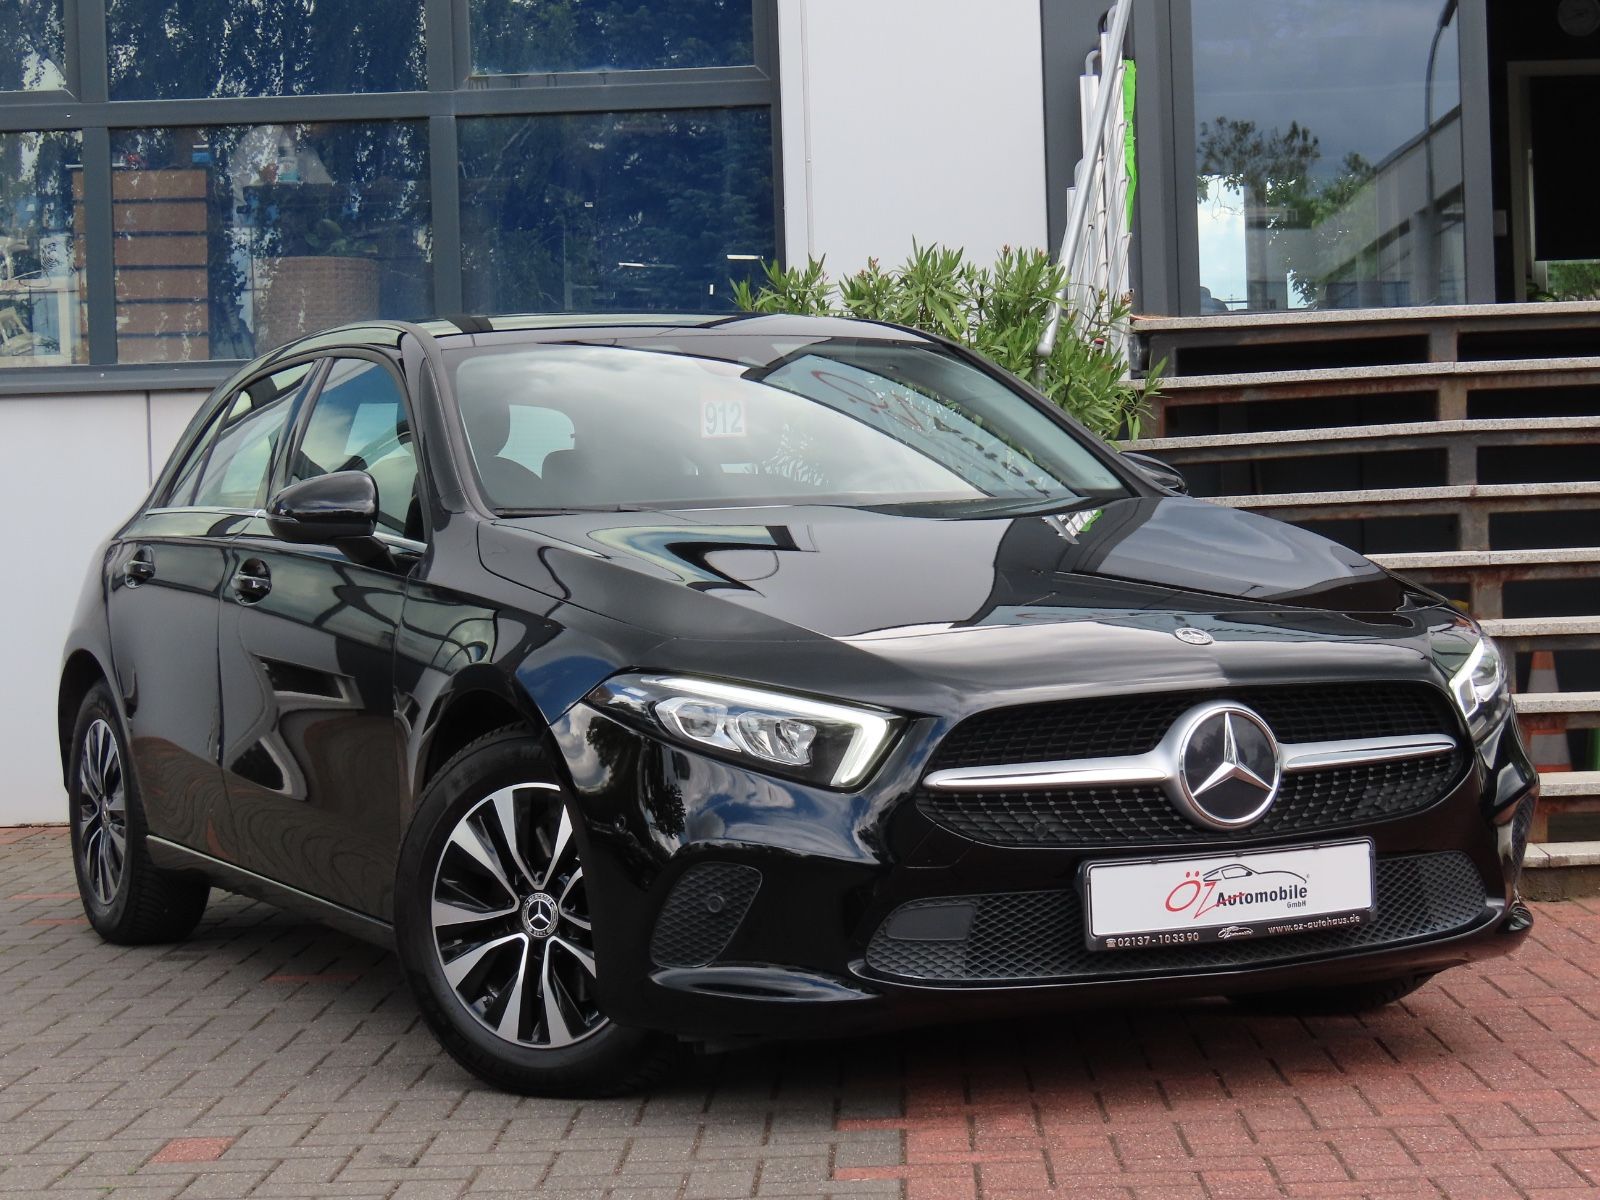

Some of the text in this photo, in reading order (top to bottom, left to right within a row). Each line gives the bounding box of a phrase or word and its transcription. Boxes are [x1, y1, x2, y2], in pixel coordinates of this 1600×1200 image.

[705, 402, 742, 435] 912
[1165, 870, 1308, 919] ÖZ Automobile
[1286, 900, 1307, 909] GmbH
[1267, 914, 1361, 934] www.oz-autohaus.de
